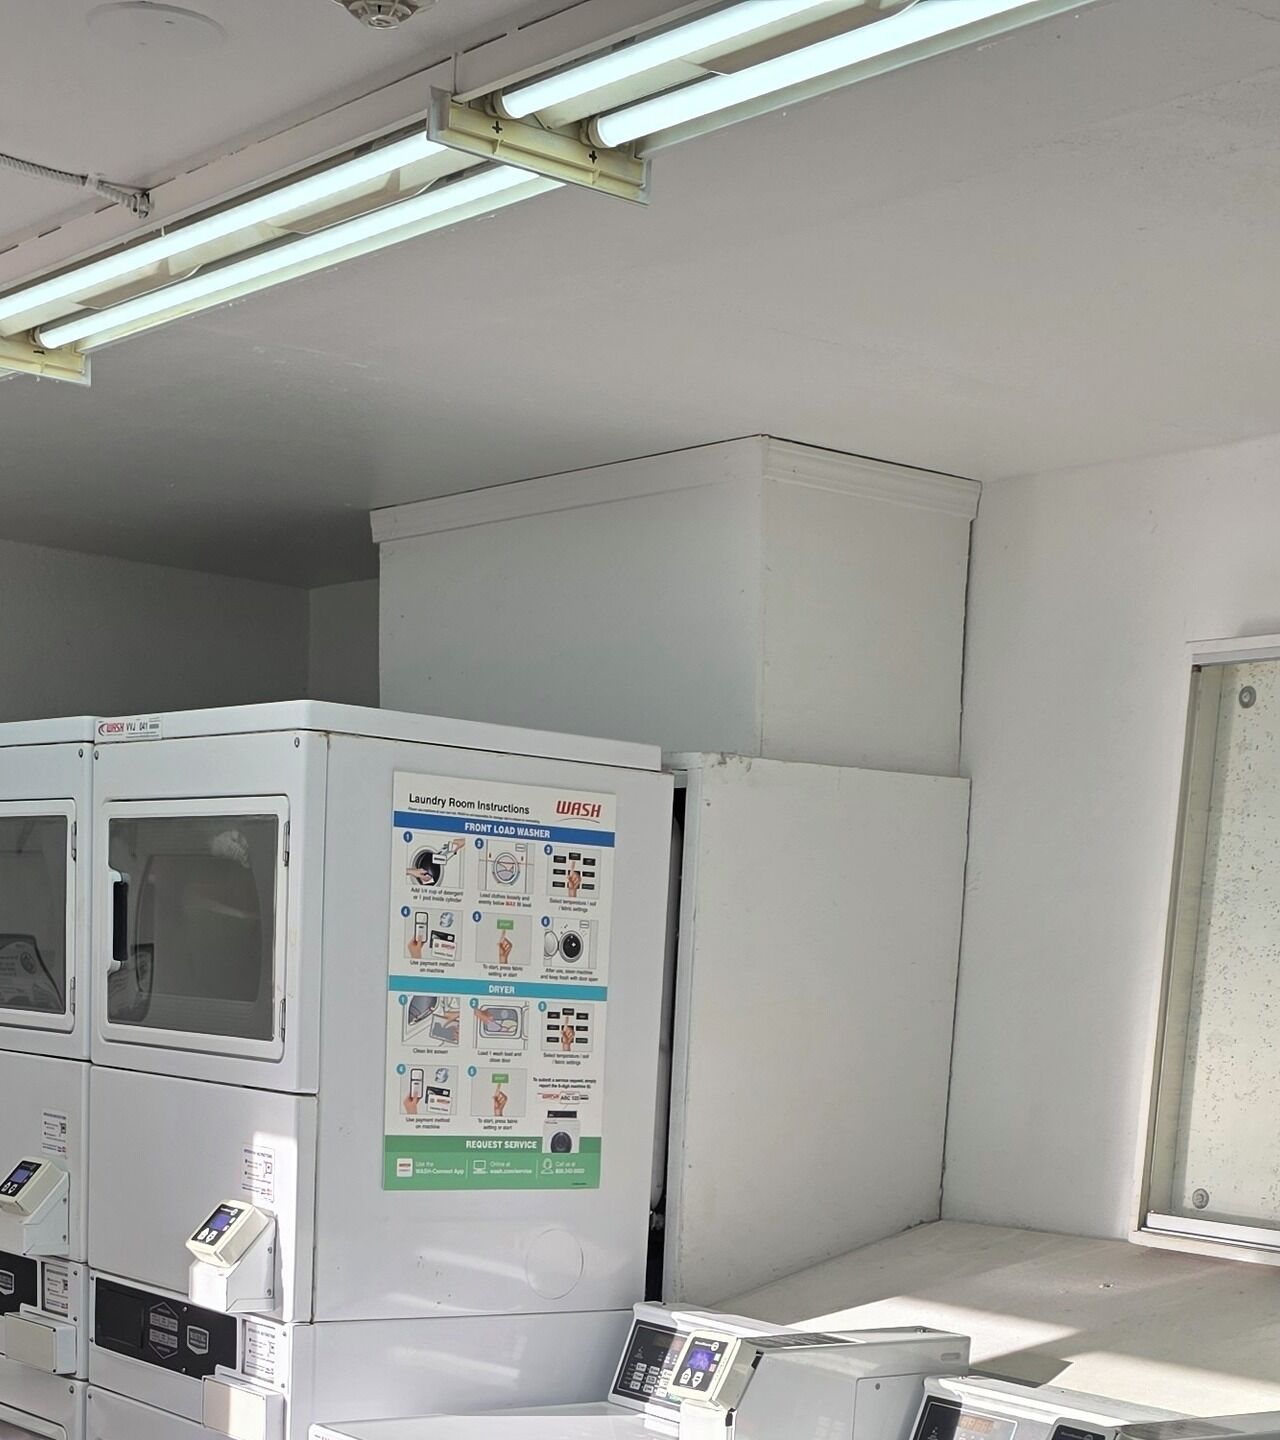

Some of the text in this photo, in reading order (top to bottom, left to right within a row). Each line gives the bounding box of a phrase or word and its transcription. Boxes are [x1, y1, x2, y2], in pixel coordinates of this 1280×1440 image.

[107, 723, 125, 732] WASH
[409, 793, 530, 815] Laundry Room Instructions
[555, 800, 602, 818] WASH
[465, 822, 551, 838] FRONT LOAD WASHER
[488, 985, 515, 994] DRYER
[466, 1140, 537, 1149] REQUEST SERVICE
